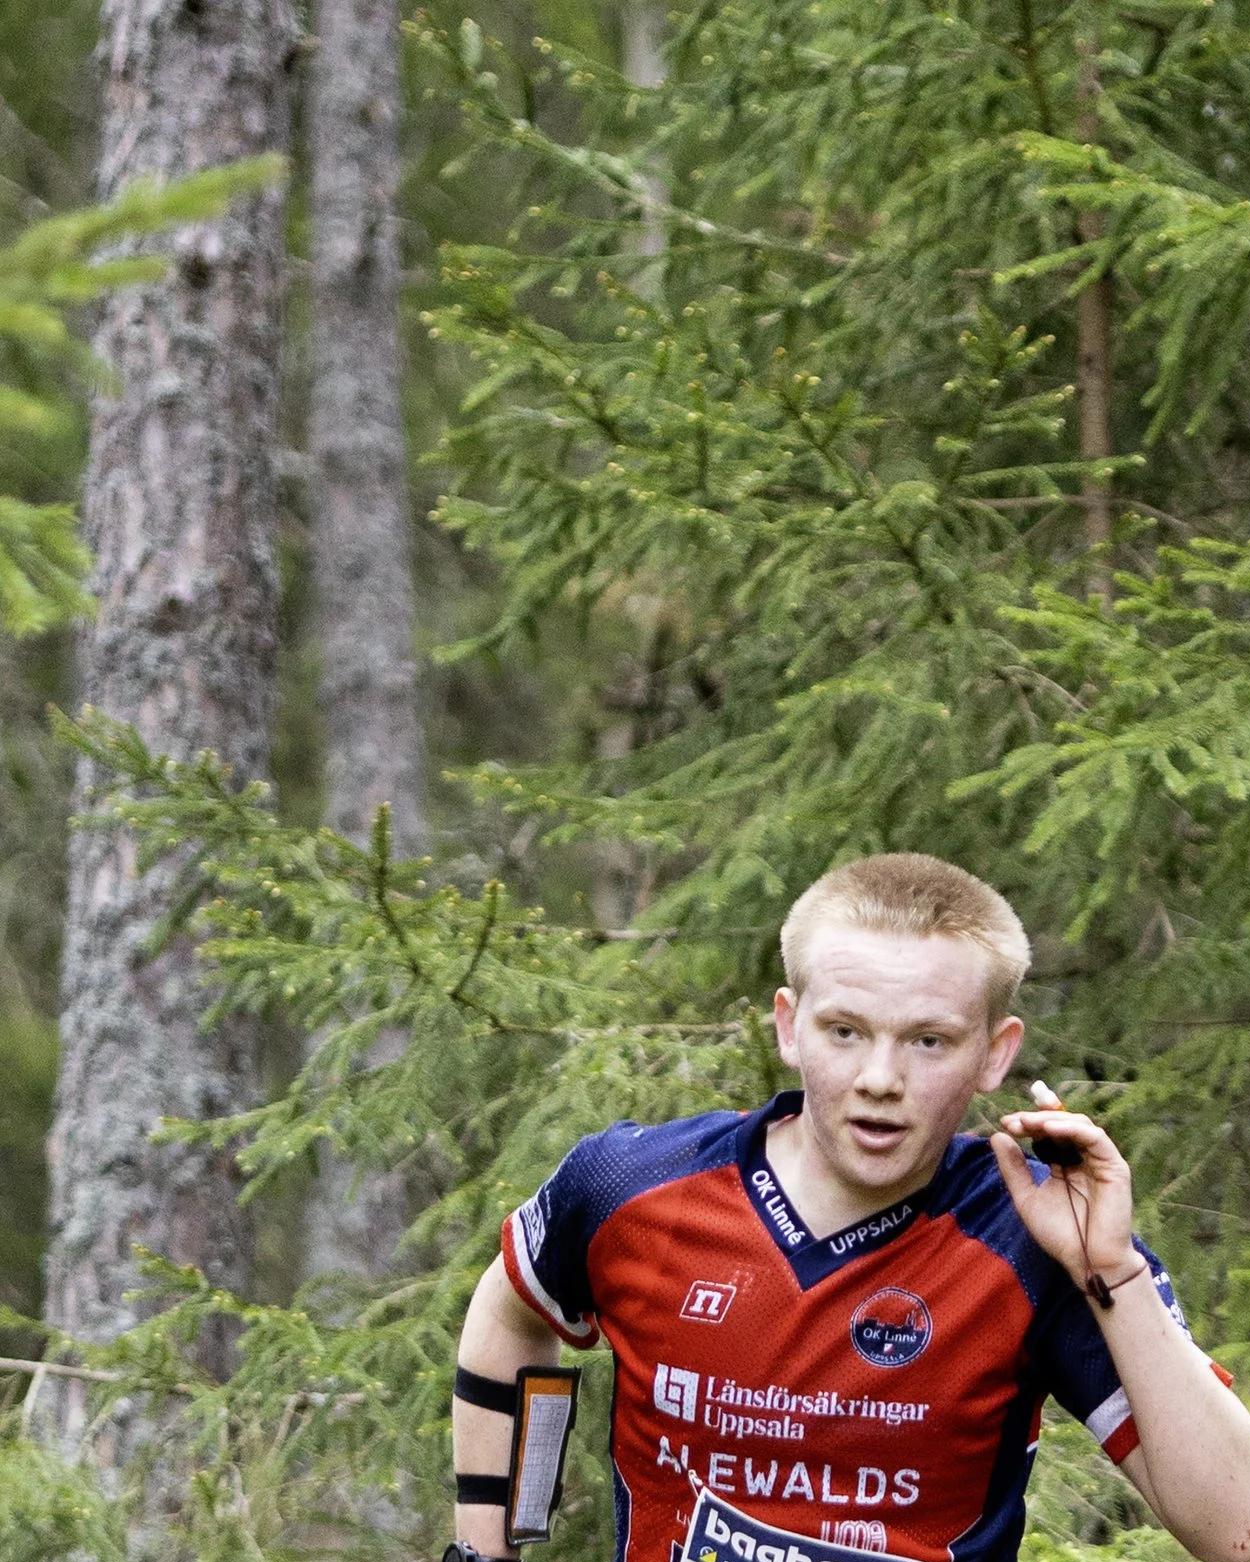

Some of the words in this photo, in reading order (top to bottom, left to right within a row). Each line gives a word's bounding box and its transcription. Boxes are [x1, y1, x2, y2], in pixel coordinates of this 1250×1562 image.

[751, 1169, 776, 1199] OK
[766, 1195, 806, 1246] Linné
[829, 1204, 913, 1254] UPPSALA
[863, 1327, 881, 1340] OK
[884, 1330, 917, 1343] Linné
[703, 1404, 805, 1440] Uppsala
[705, 1375, 931, 1426] Länsförsäkringar
